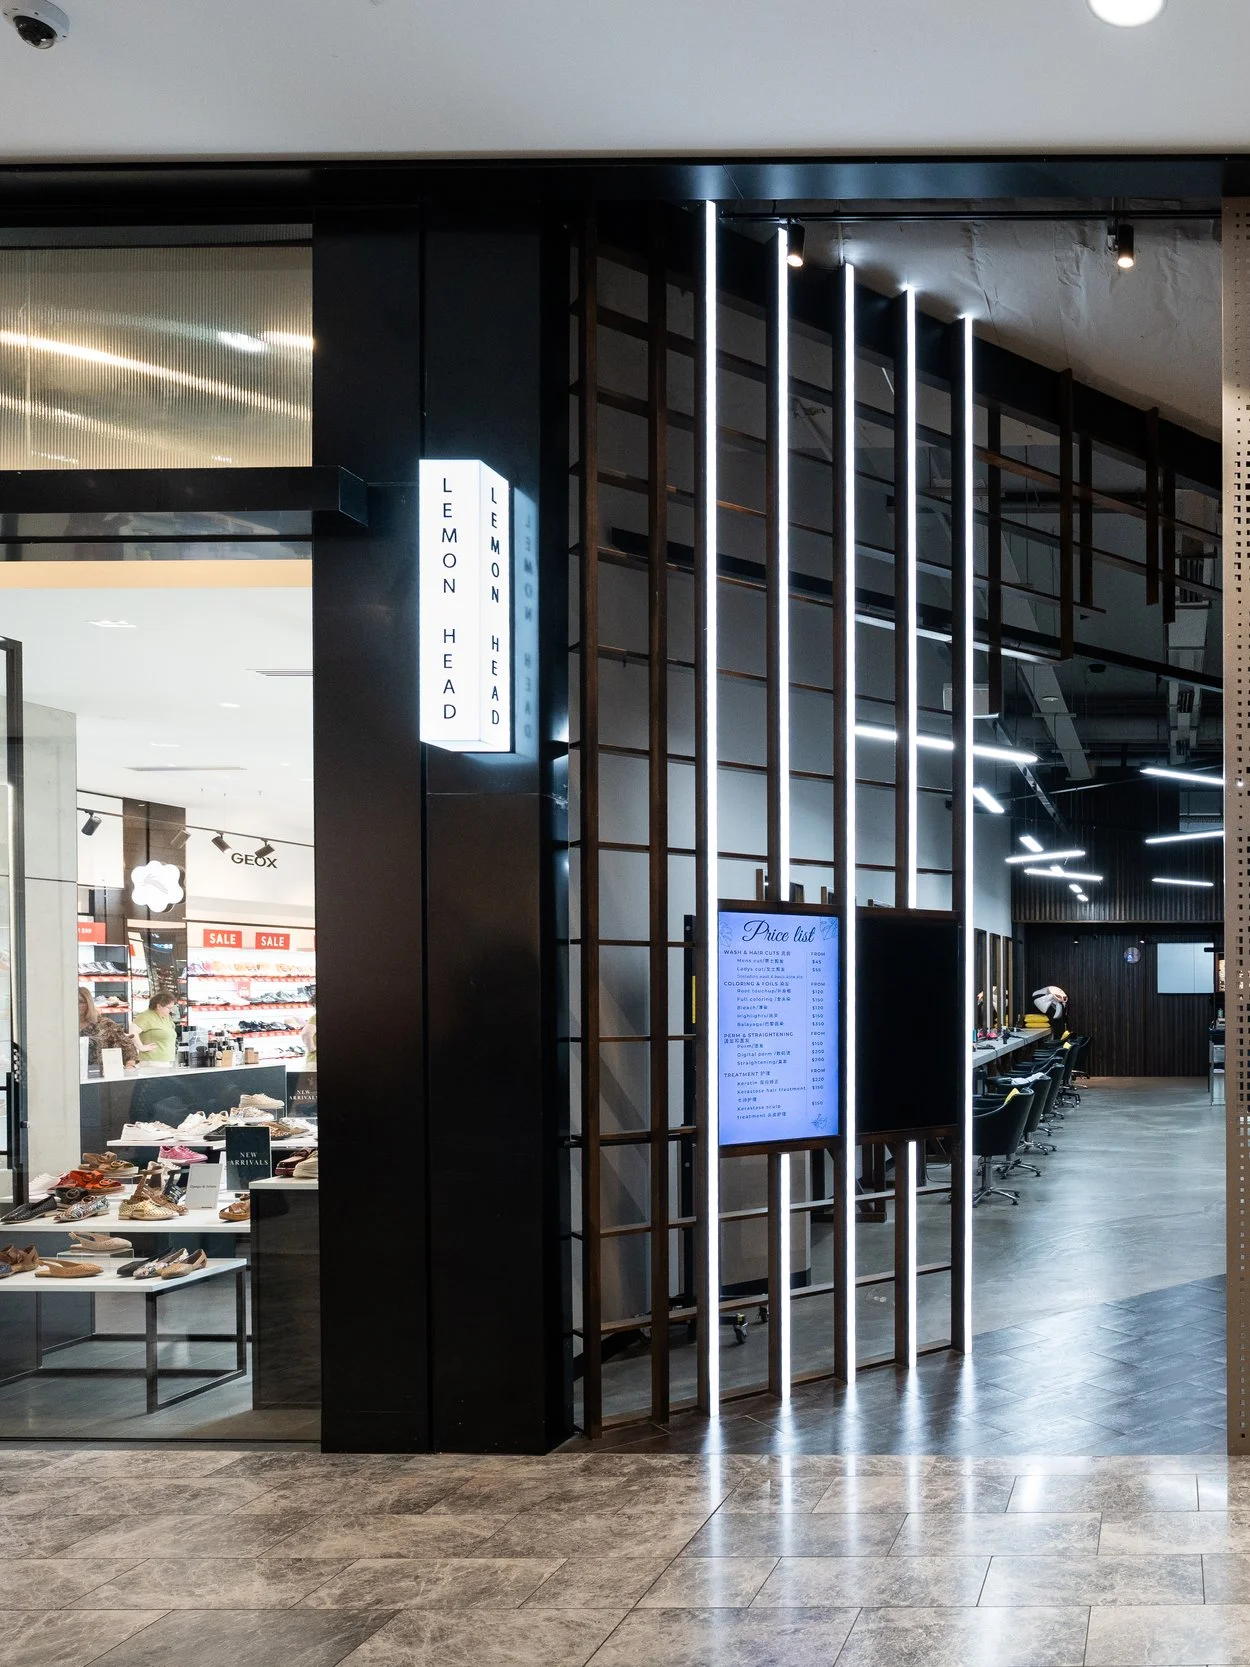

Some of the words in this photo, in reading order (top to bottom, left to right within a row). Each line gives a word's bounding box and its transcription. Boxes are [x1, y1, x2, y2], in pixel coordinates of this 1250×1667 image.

[442, 478, 457, 593] LEMON
[491, 487, 500, 603] LEMON
[443, 629, 457, 719] HEAD
[491, 635, 500, 725] HEAD
[231, 852, 278, 869] GEOX
[209, 933, 236, 945] SALE
[261, 935, 284, 947] SALE
[742, 920, 789, 942] Price
[794, 925, 816, 942] list
